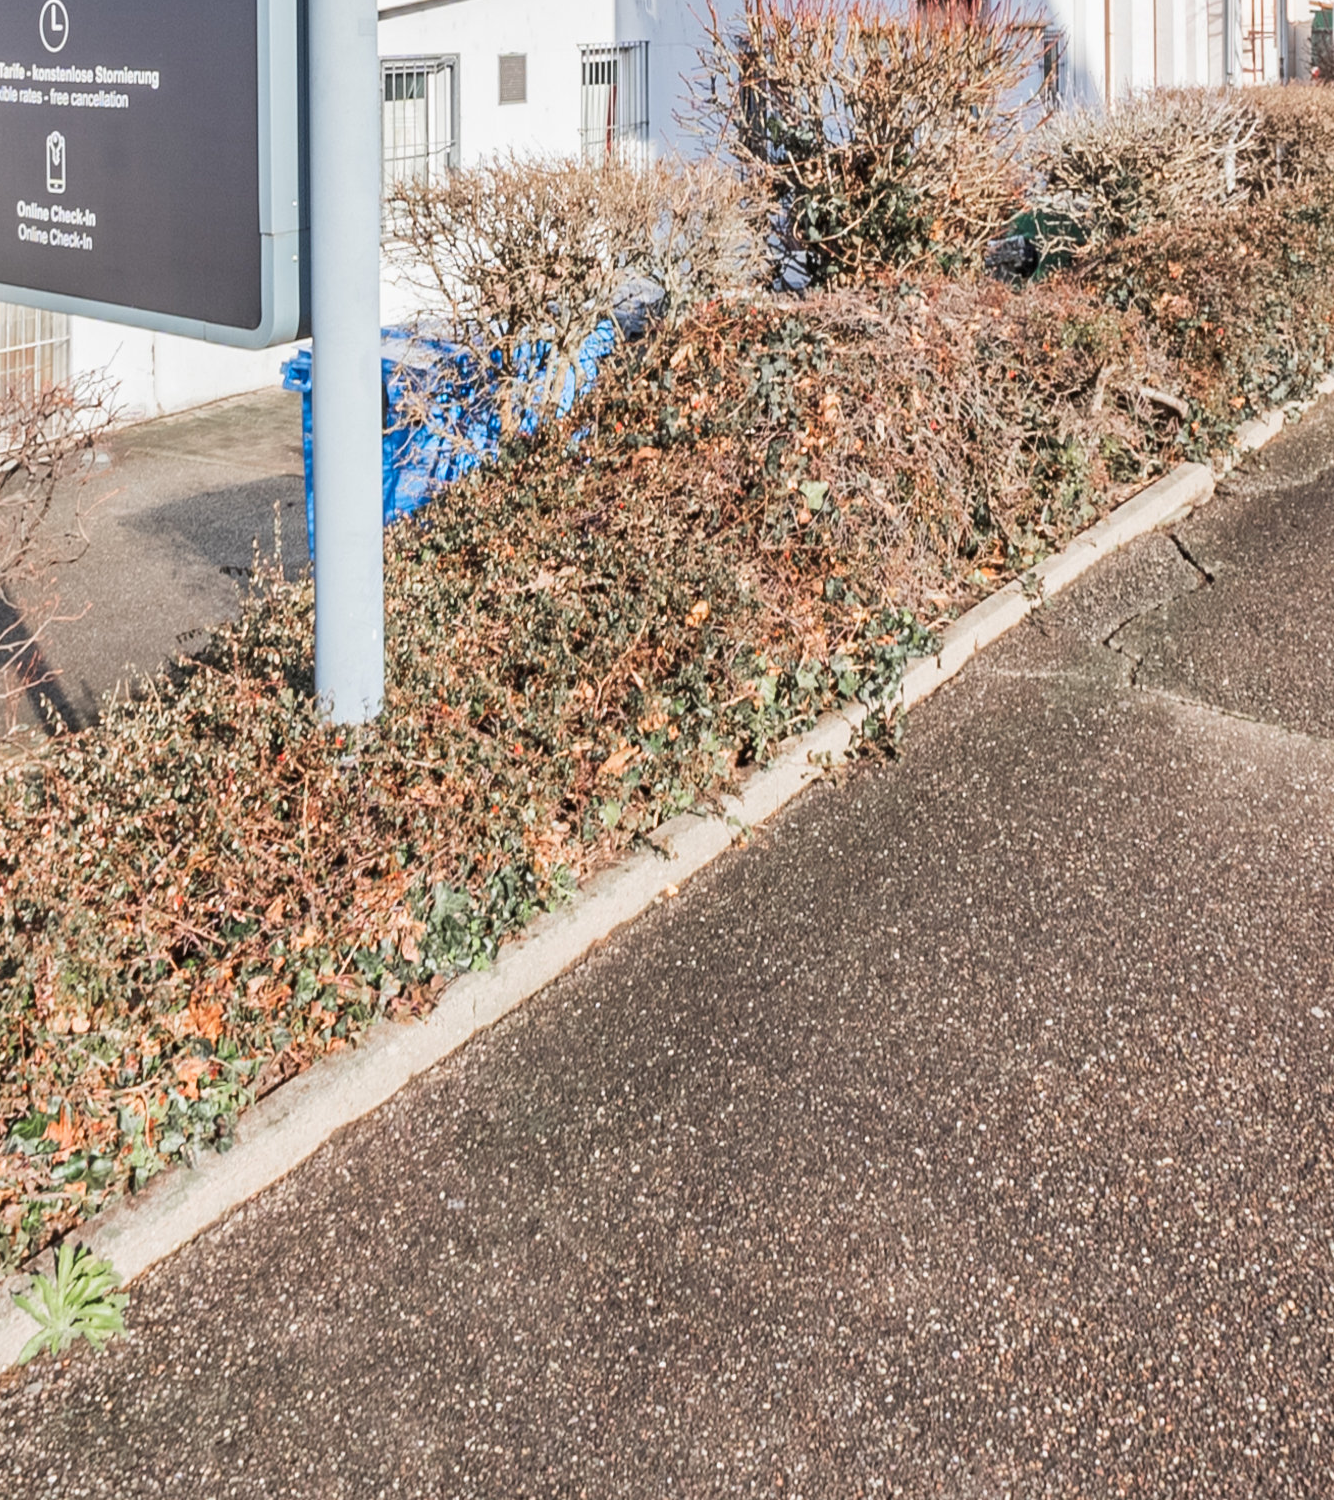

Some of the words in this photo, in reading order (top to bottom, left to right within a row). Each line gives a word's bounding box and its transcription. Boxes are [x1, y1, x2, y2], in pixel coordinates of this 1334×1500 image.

[32, 63, 94, 83] konstenlose
[95, 65, 160, 89] Stornierung
[19, 87, 43, 105] rates
[49, 87, 69, 106] free
[70, 89, 129, 108] cancellation
[17, 200, 49, 222] Online
[50, 205, 96, 227] Check-In
[18, 223, 48, 245] Online
[49, 228, 93, 251] Check-In
